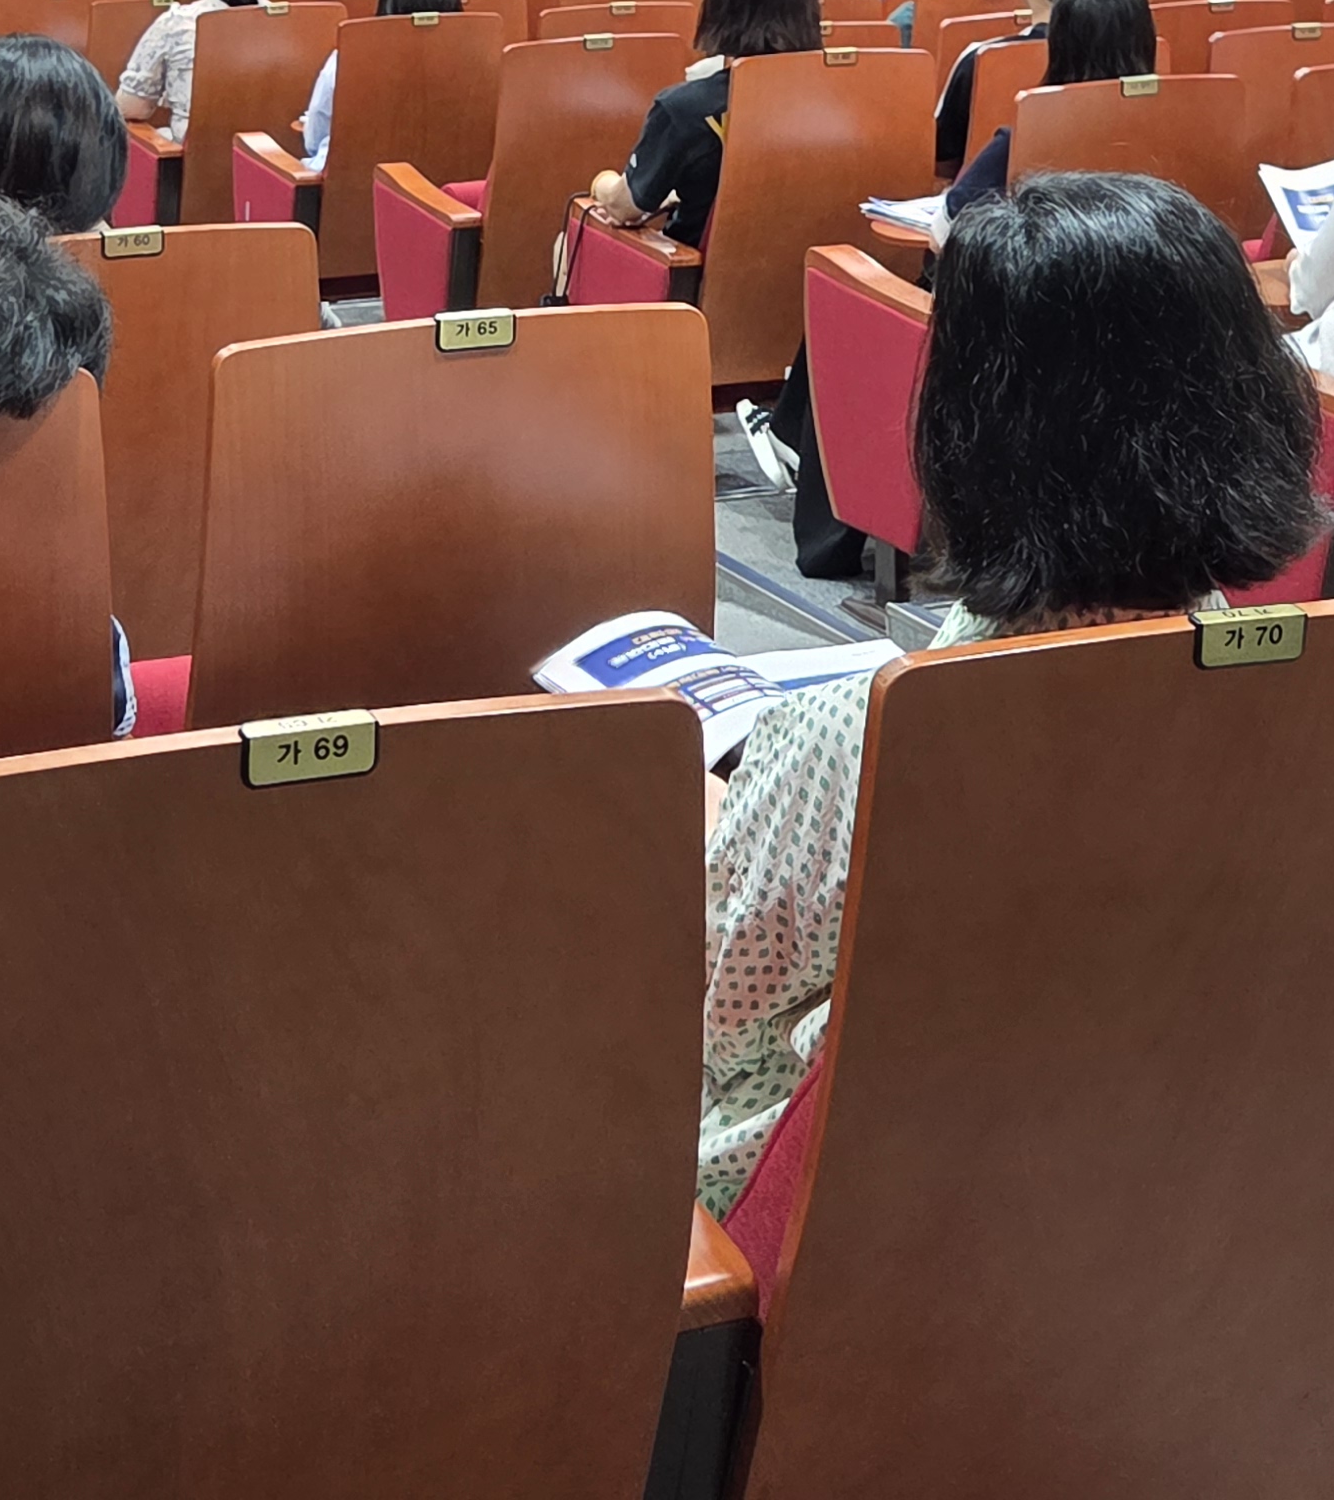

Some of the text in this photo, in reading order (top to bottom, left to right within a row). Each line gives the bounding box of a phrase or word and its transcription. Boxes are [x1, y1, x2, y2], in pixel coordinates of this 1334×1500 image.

[117, 234, 150, 248] 가 60
[455, 320, 498, 338] 가 65
[1224, 623, 1283, 650] 가 70
[277, 734, 349, 766] 가 69
